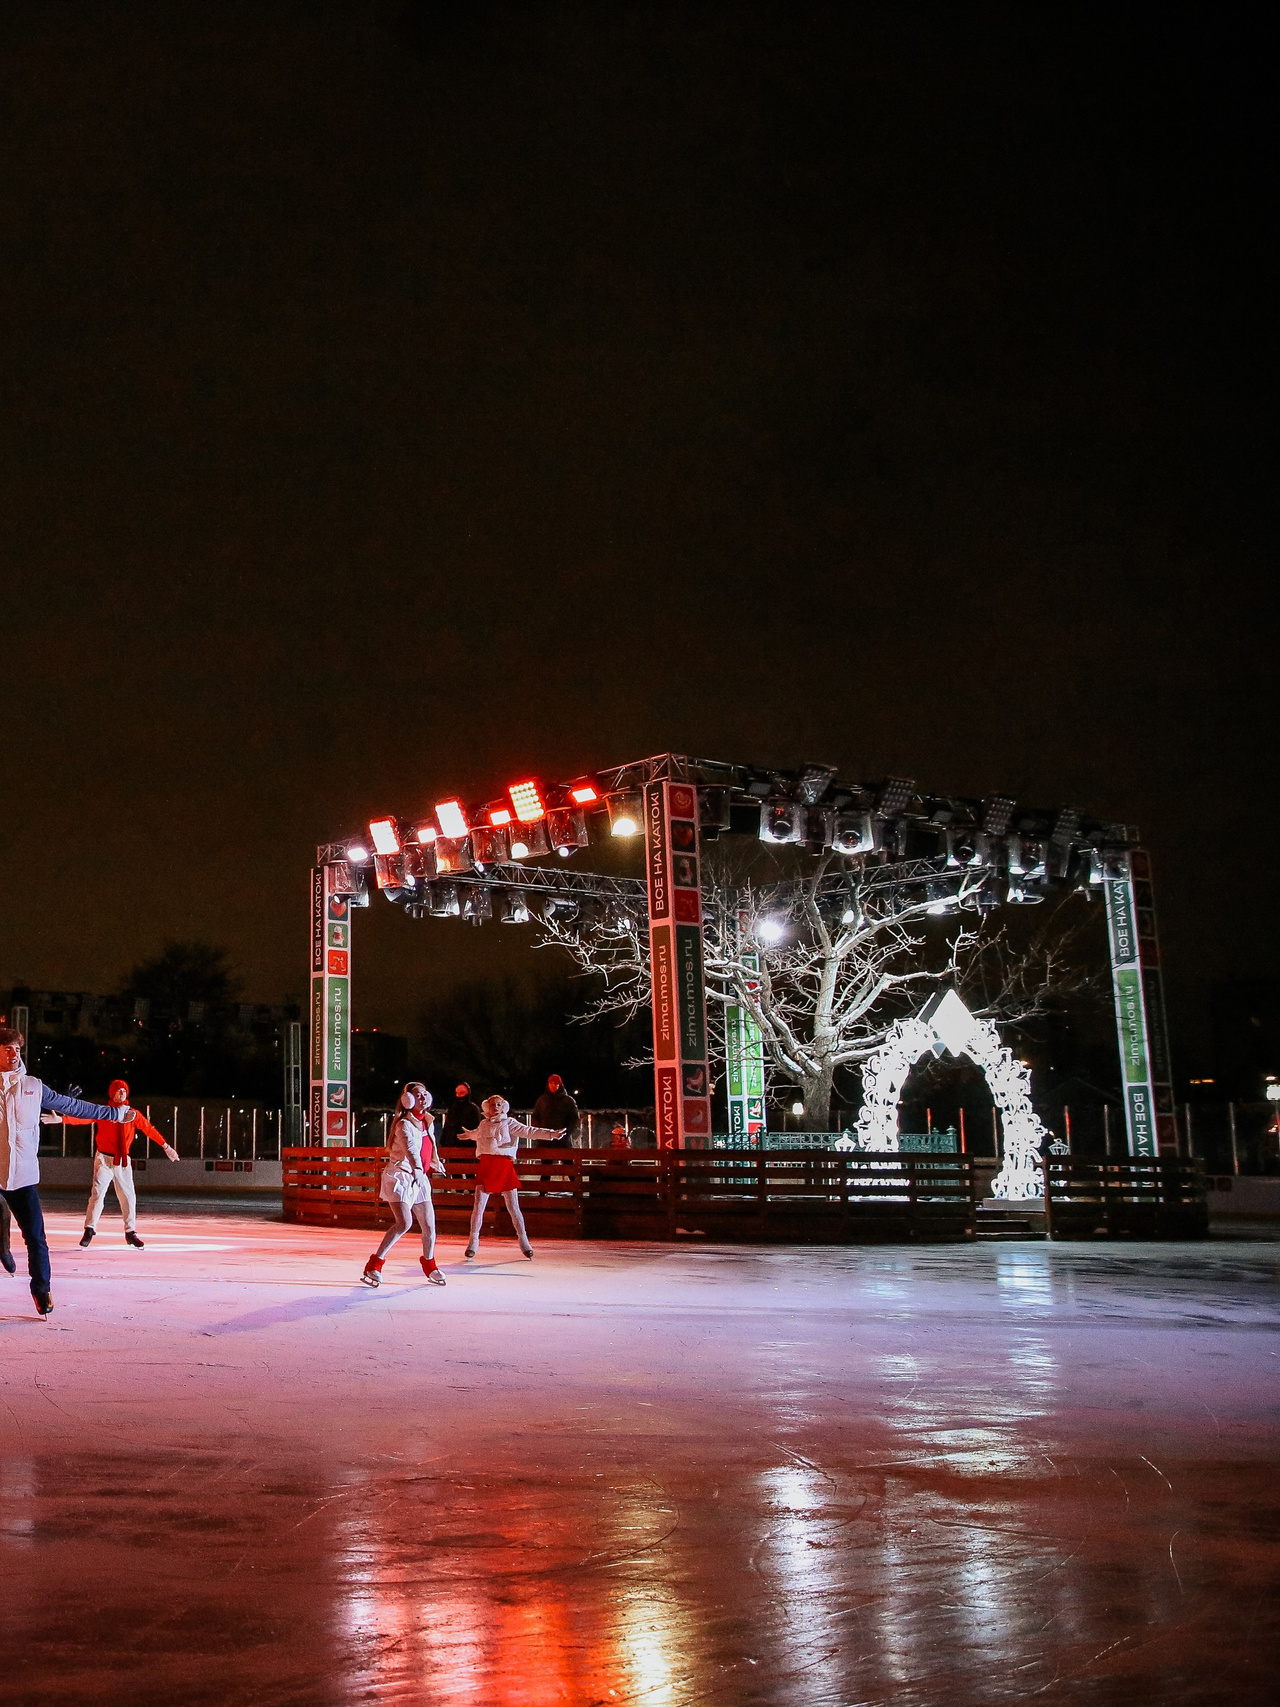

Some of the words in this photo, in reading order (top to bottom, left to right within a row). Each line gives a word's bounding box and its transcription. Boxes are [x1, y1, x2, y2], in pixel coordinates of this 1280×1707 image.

[650, 791, 661, 848] КАТОК!
[653, 851, 663, 874] НА
[654, 877, 665, 911] ВСЕ
[1115, 906, 1127, 927] НА
[315, 919, 322, 938] НА
[658, 944, 670, 1041] zima.mos.ru
[682, 939, 697, 1047] zima.mos.ru
[314, 991, 322, 1065] zima.mos.ru
[332, 988, 342, 1071] zima.mos.ru
[313, 1092, 321, 1138] КАТОК!
[662, 1076, 674, 1135] КАТОК!
[1133, 1093, 1146, 1122] ВСЕ
[1135, 1123, 1147, 1144] НА
